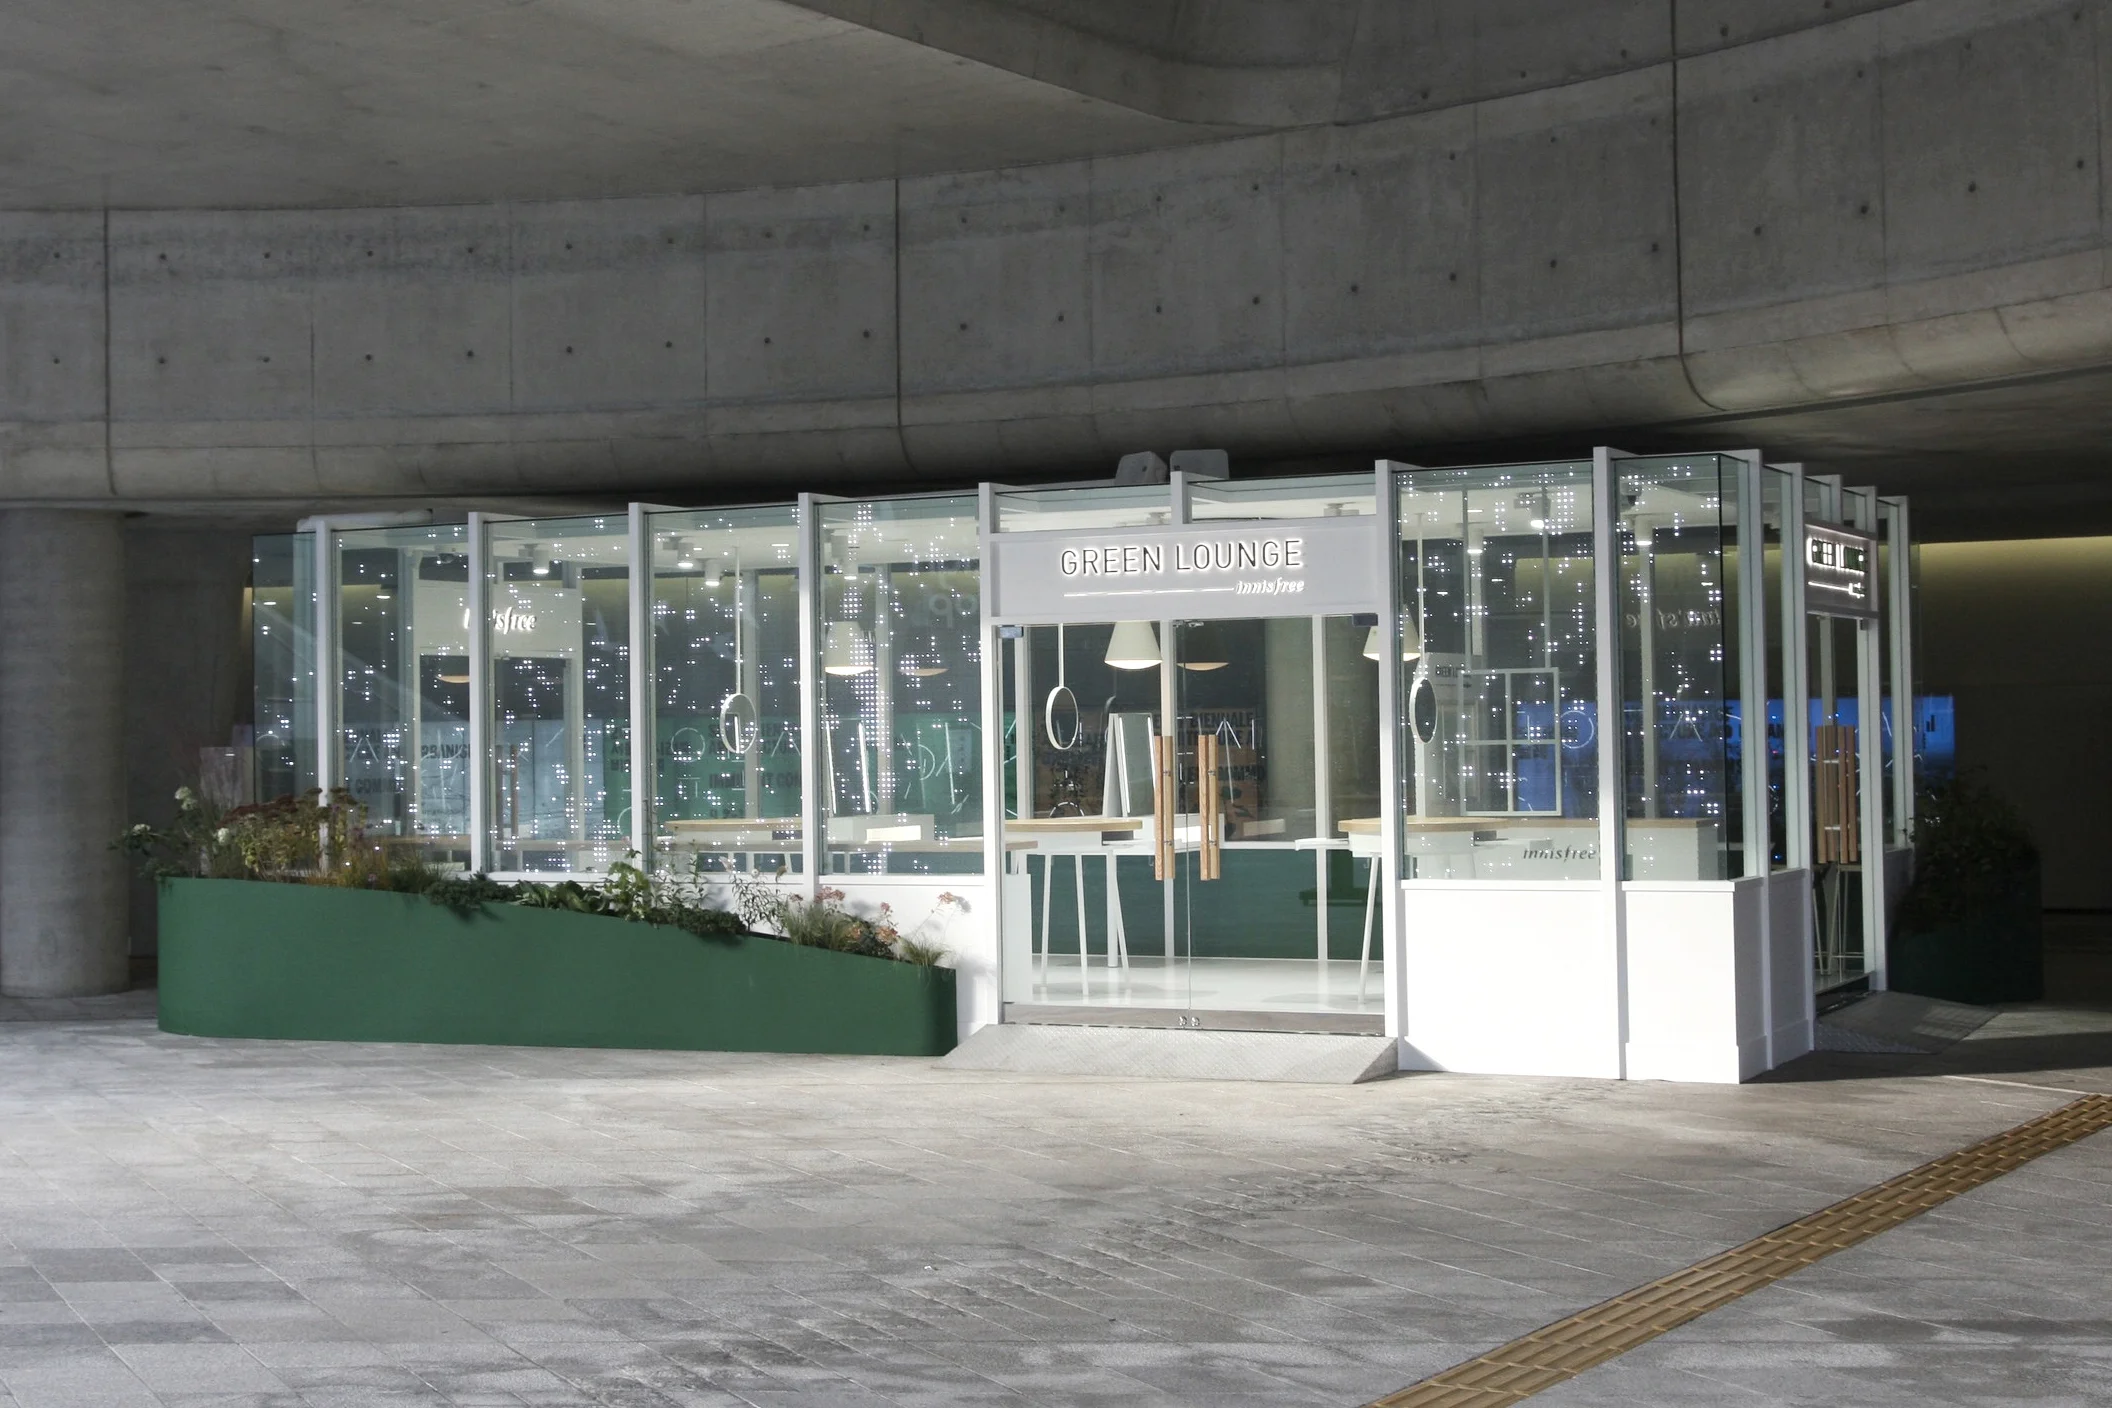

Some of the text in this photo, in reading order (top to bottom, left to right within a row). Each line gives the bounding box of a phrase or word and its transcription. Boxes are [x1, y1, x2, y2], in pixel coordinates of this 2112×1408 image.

[1061, 540, 1302, 575] GREEN LOUNGE
[1236, 576, 1305, 596] innisfree
[1523, 844, 1597, 863] innisfree
